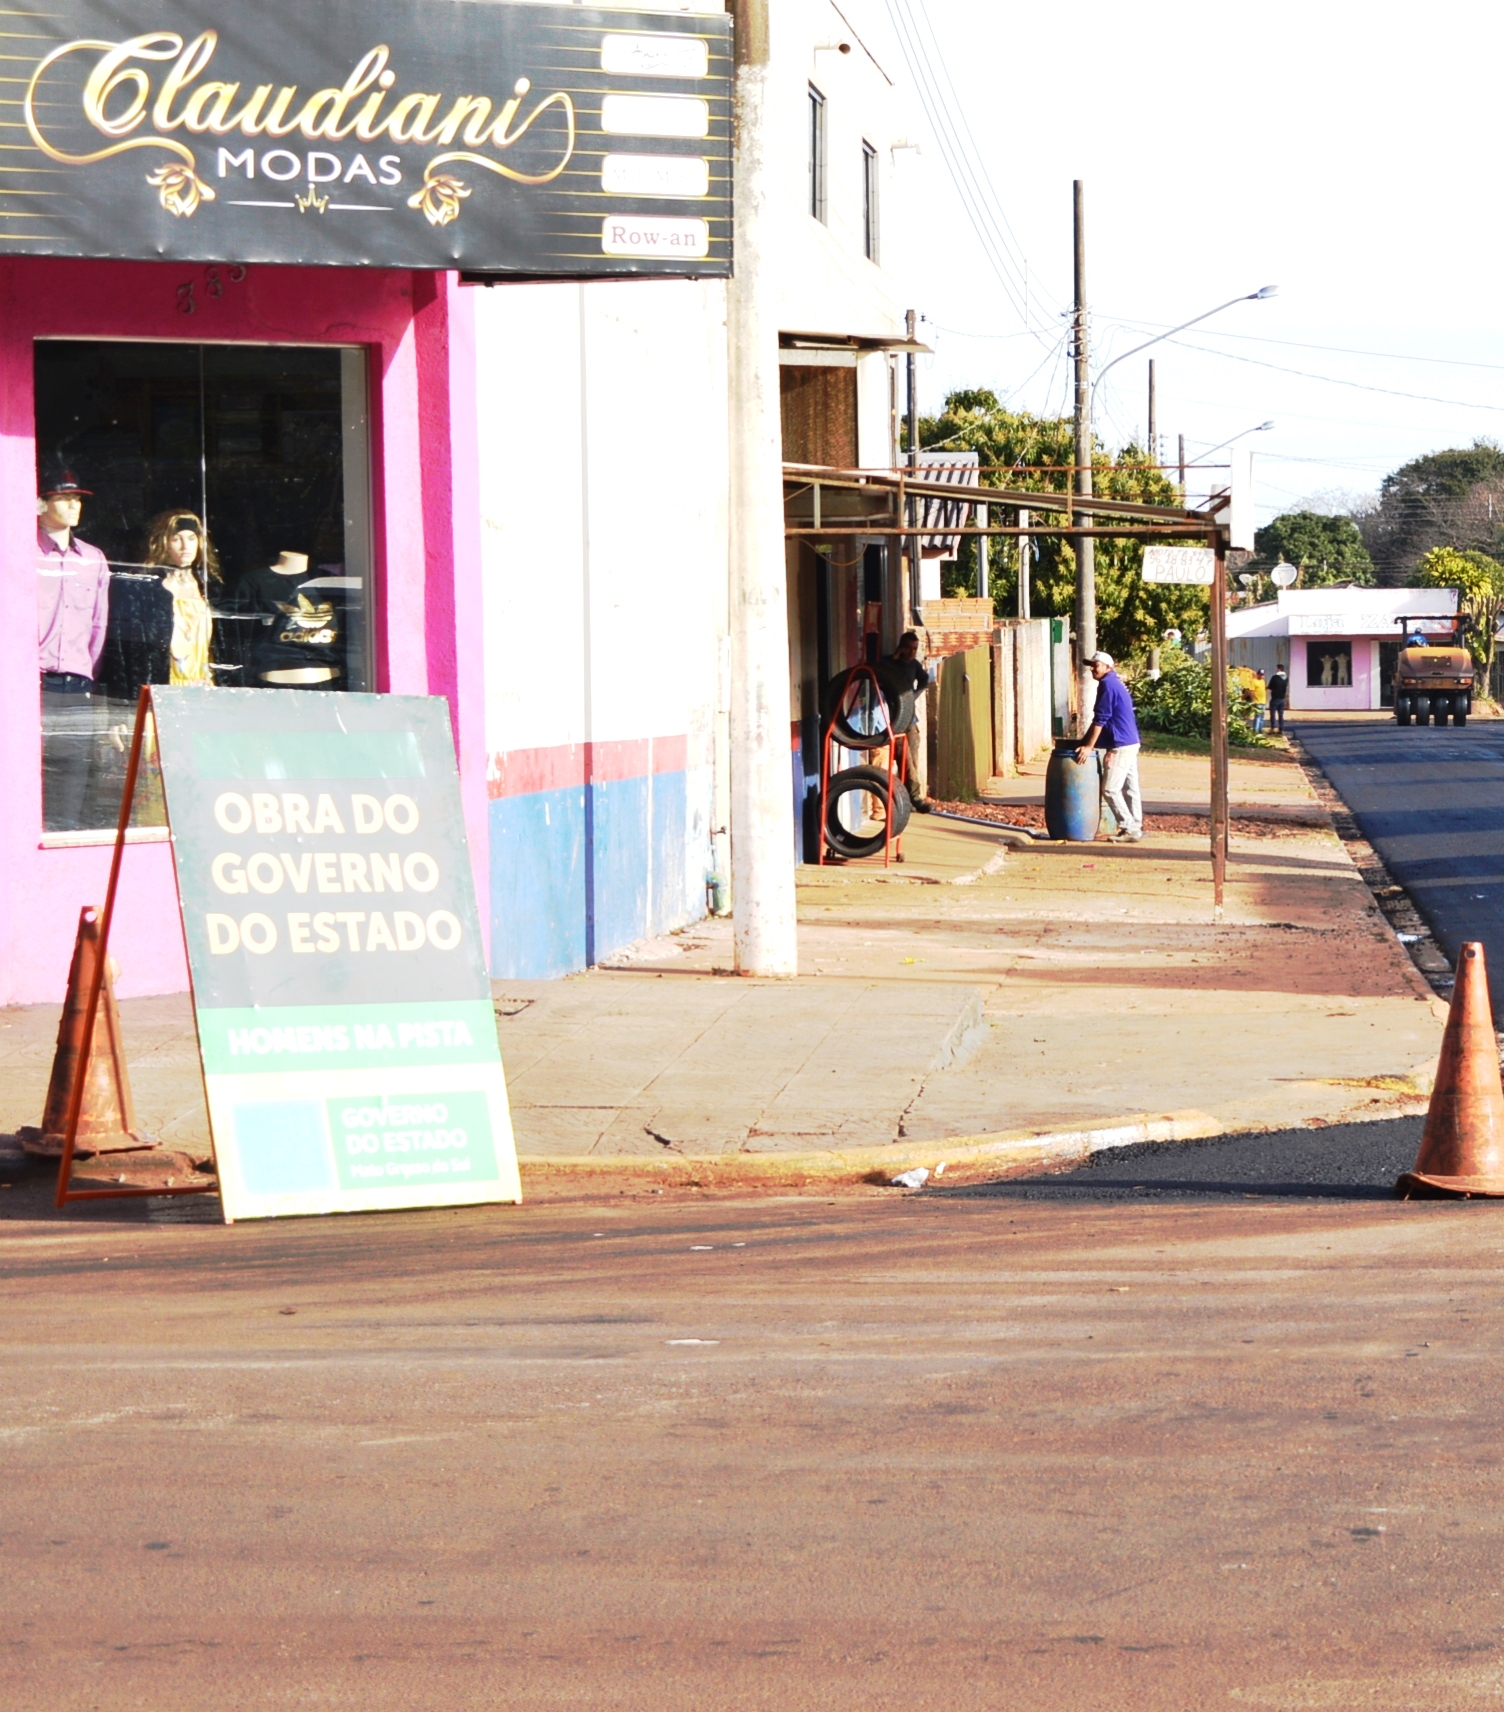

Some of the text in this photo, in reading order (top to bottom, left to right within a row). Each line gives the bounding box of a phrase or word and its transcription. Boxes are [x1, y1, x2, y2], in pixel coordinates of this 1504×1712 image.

[84, 29, 535, 148] Claudiani
[217, 147, 402, 185] MODAS
[611, 226, 697, 246] Row-an
[1155, 565, 1206, 581] PAULO
[214, 792, 419, 834] OBRA DO
[211, 852, 439, 894] GOVERNO
[206, 910, 461, 955] DO ESTADO
[228, 1020, 473, 1055] HOMENS NA PISTA
[341, 1103, 448, 1128] GOVERNO
[345, 1128, 467, 1155] DO ESTADO
[350, 1164, 384, 1178] Mato
[432, 1158, 449, 1173] do
[451, 1157, 471, 1171] Sul
